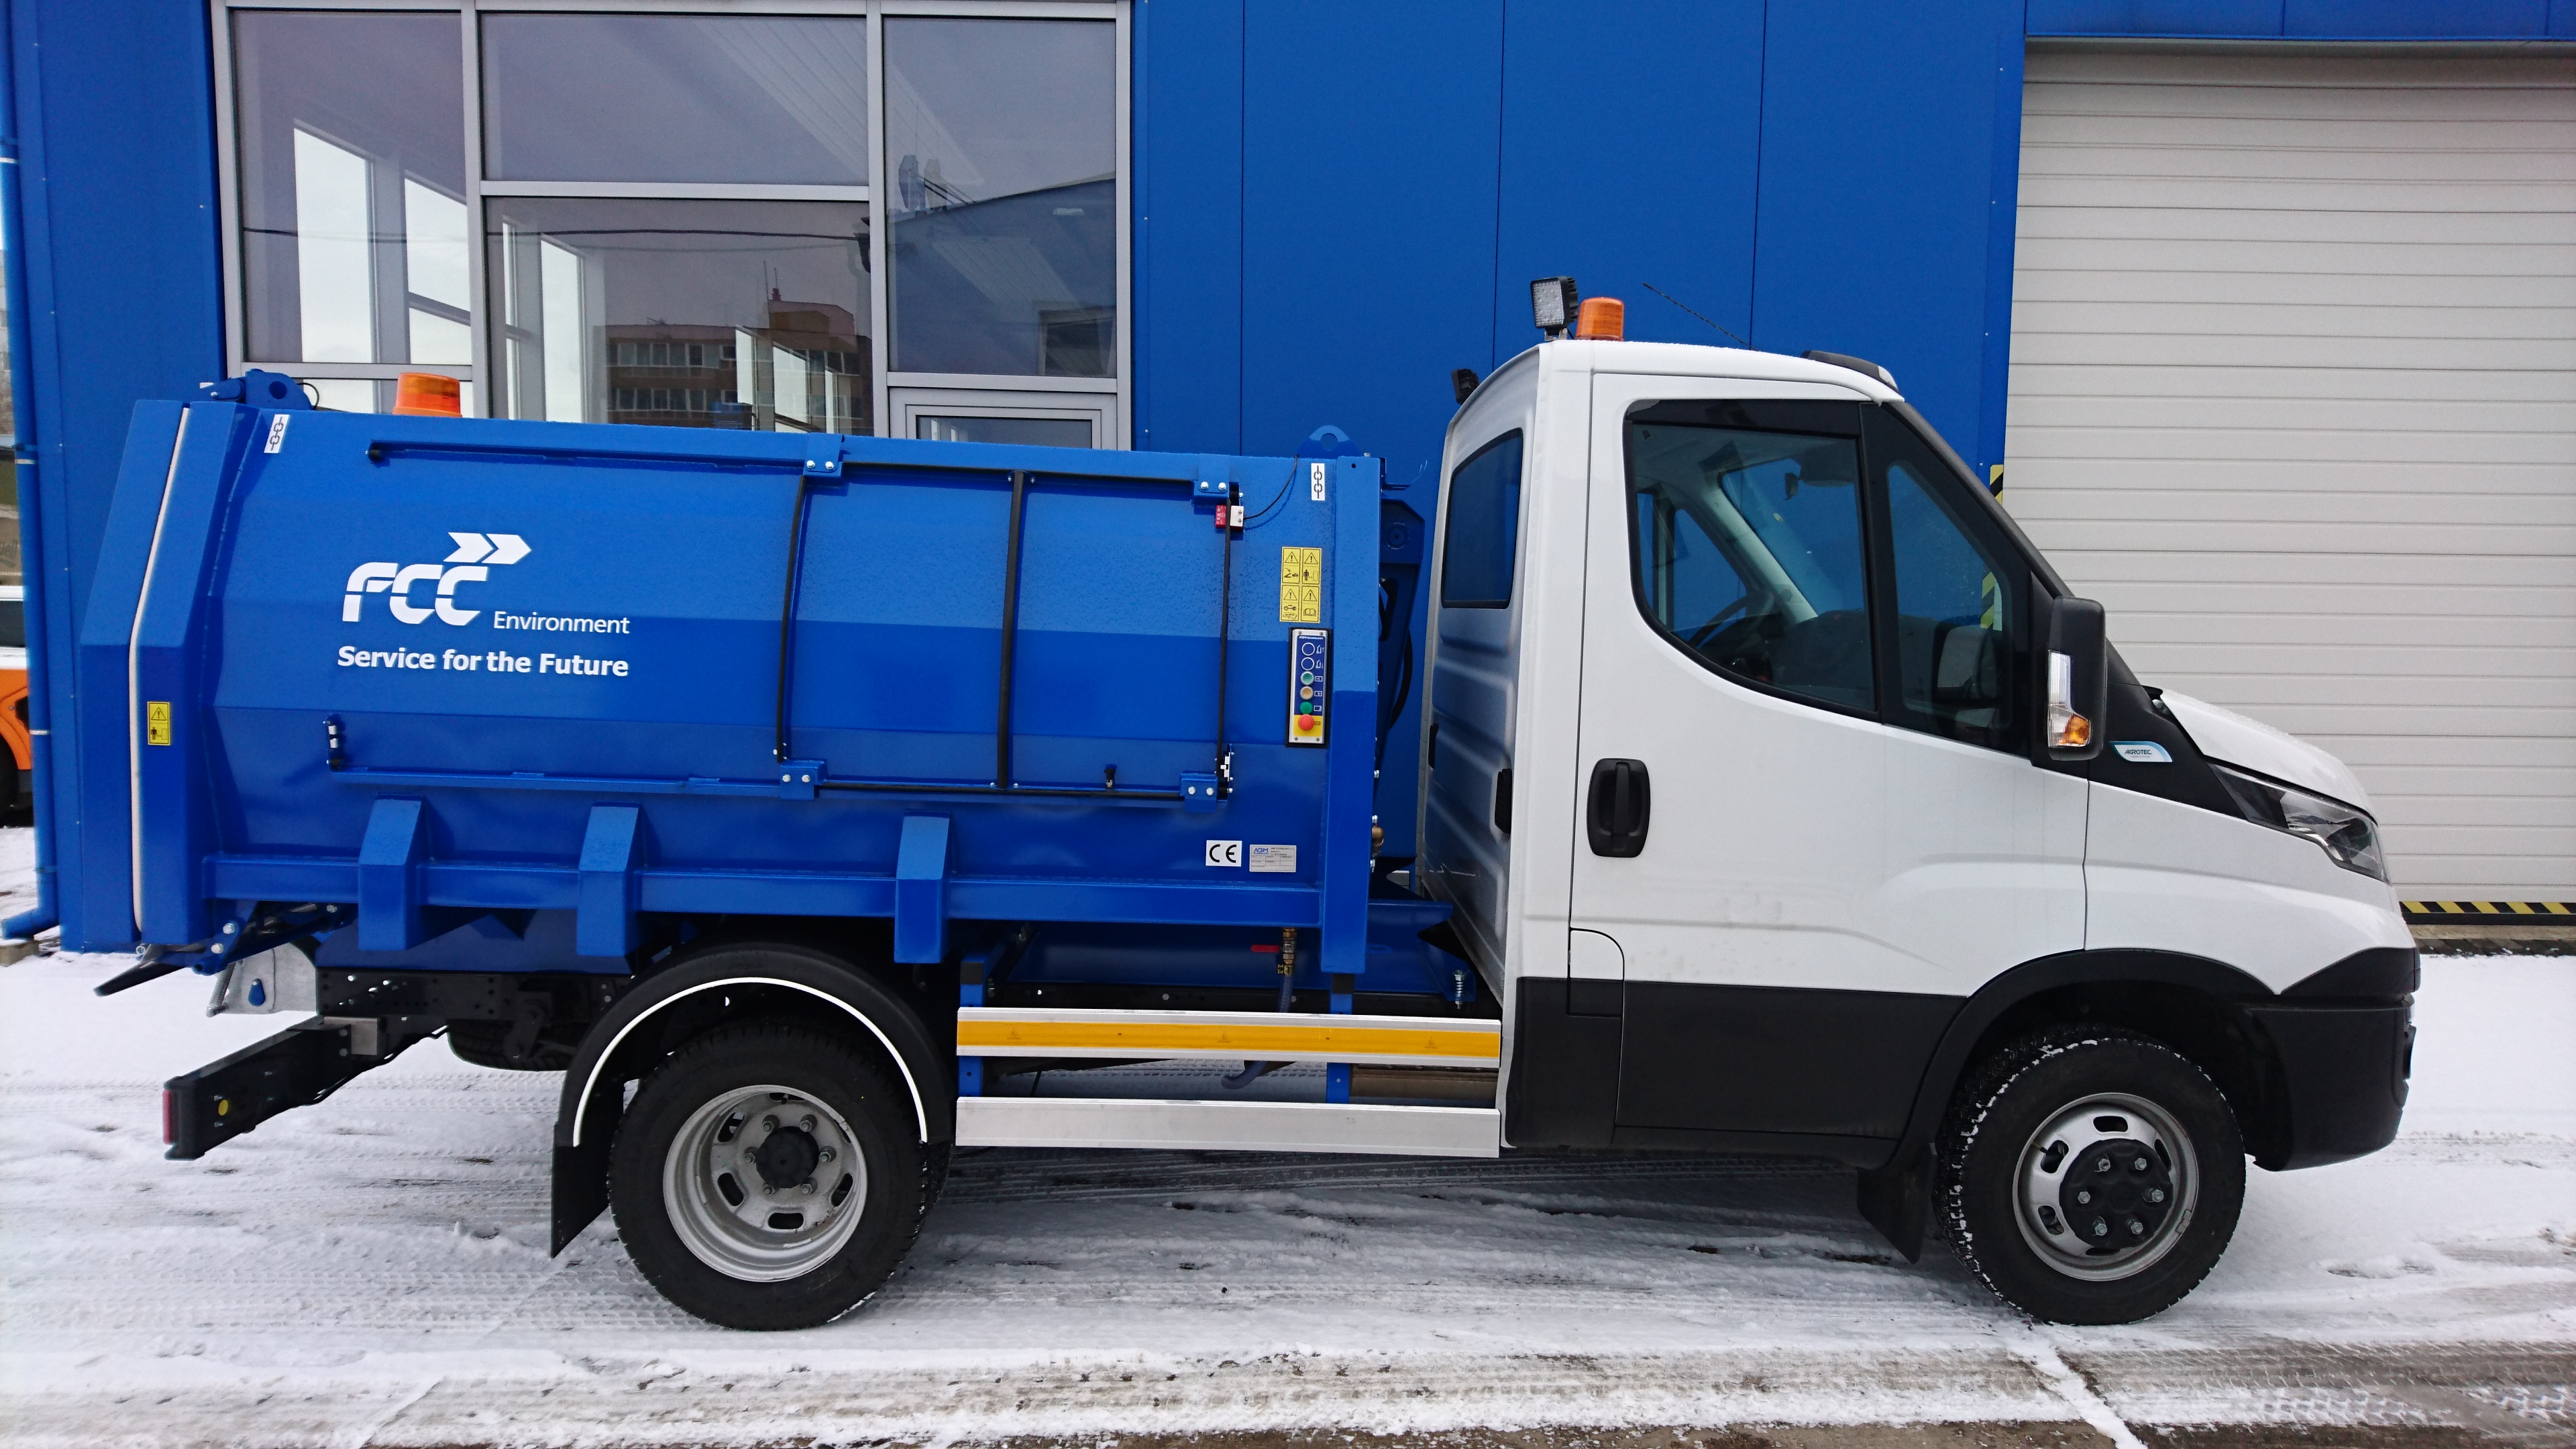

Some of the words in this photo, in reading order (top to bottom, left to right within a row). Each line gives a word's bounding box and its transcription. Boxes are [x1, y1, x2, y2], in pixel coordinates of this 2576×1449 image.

[342, 561, 488, 626] FCC
[493, 610, 630, 634] Environment
[337, 645, 435, 669] Service
[442, 649, 482, 671] for
[486, 651, 531, 673] the
[539, 653, 629, 677] Future
[1209, 844, 1237, 863] CE
